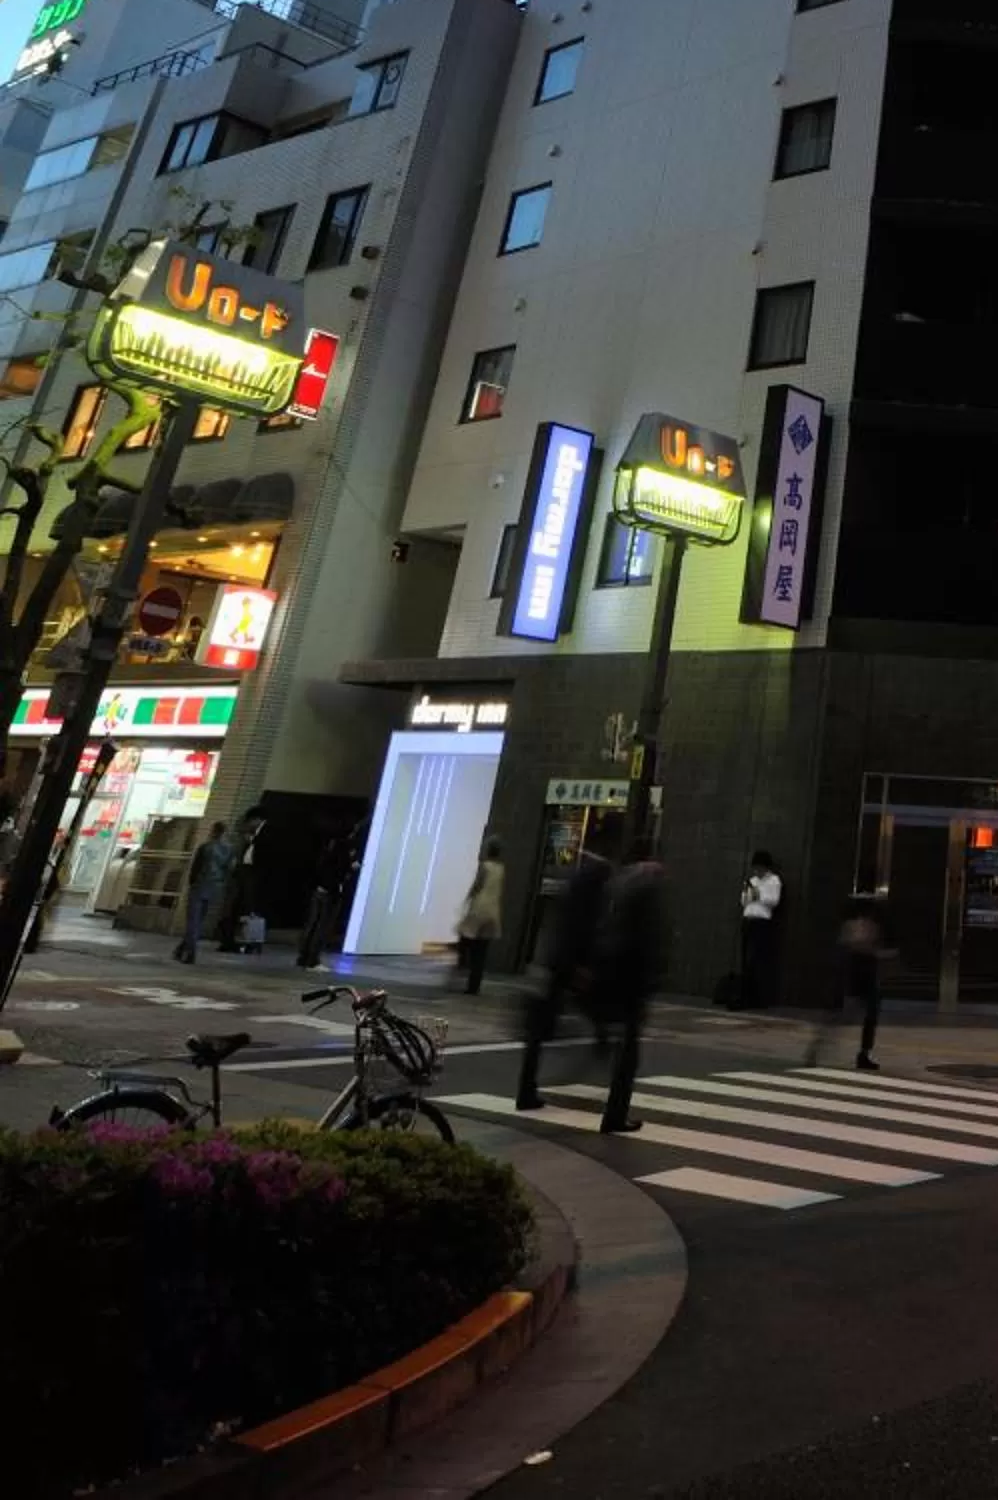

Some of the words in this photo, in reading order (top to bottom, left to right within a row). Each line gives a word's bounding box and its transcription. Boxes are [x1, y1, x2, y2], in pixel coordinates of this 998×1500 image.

[773, 471, 804, 603] 高岡屋
[411, 694, 475, 733] dormy
